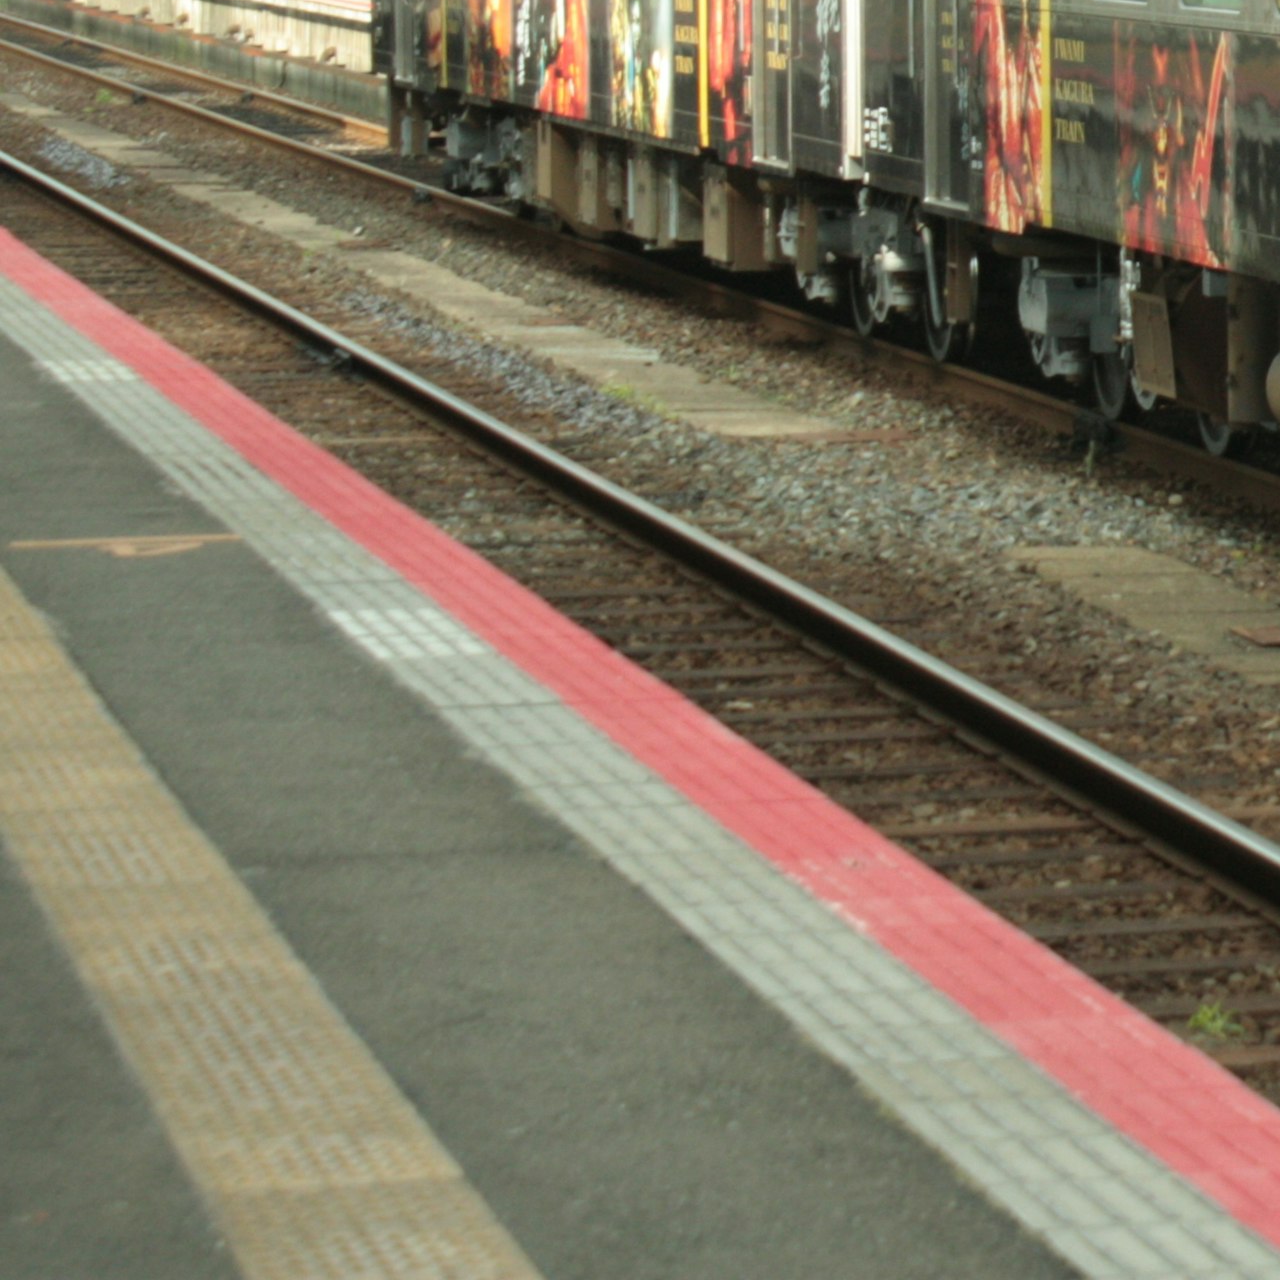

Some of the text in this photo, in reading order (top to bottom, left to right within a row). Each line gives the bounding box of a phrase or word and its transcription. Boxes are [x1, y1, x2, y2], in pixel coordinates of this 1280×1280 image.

[1055, 37, 1084, 63] IWAMI
[1055, 78, 1094, 105] KAGURA
[1055, 117, 1085, 144] TRAIN
